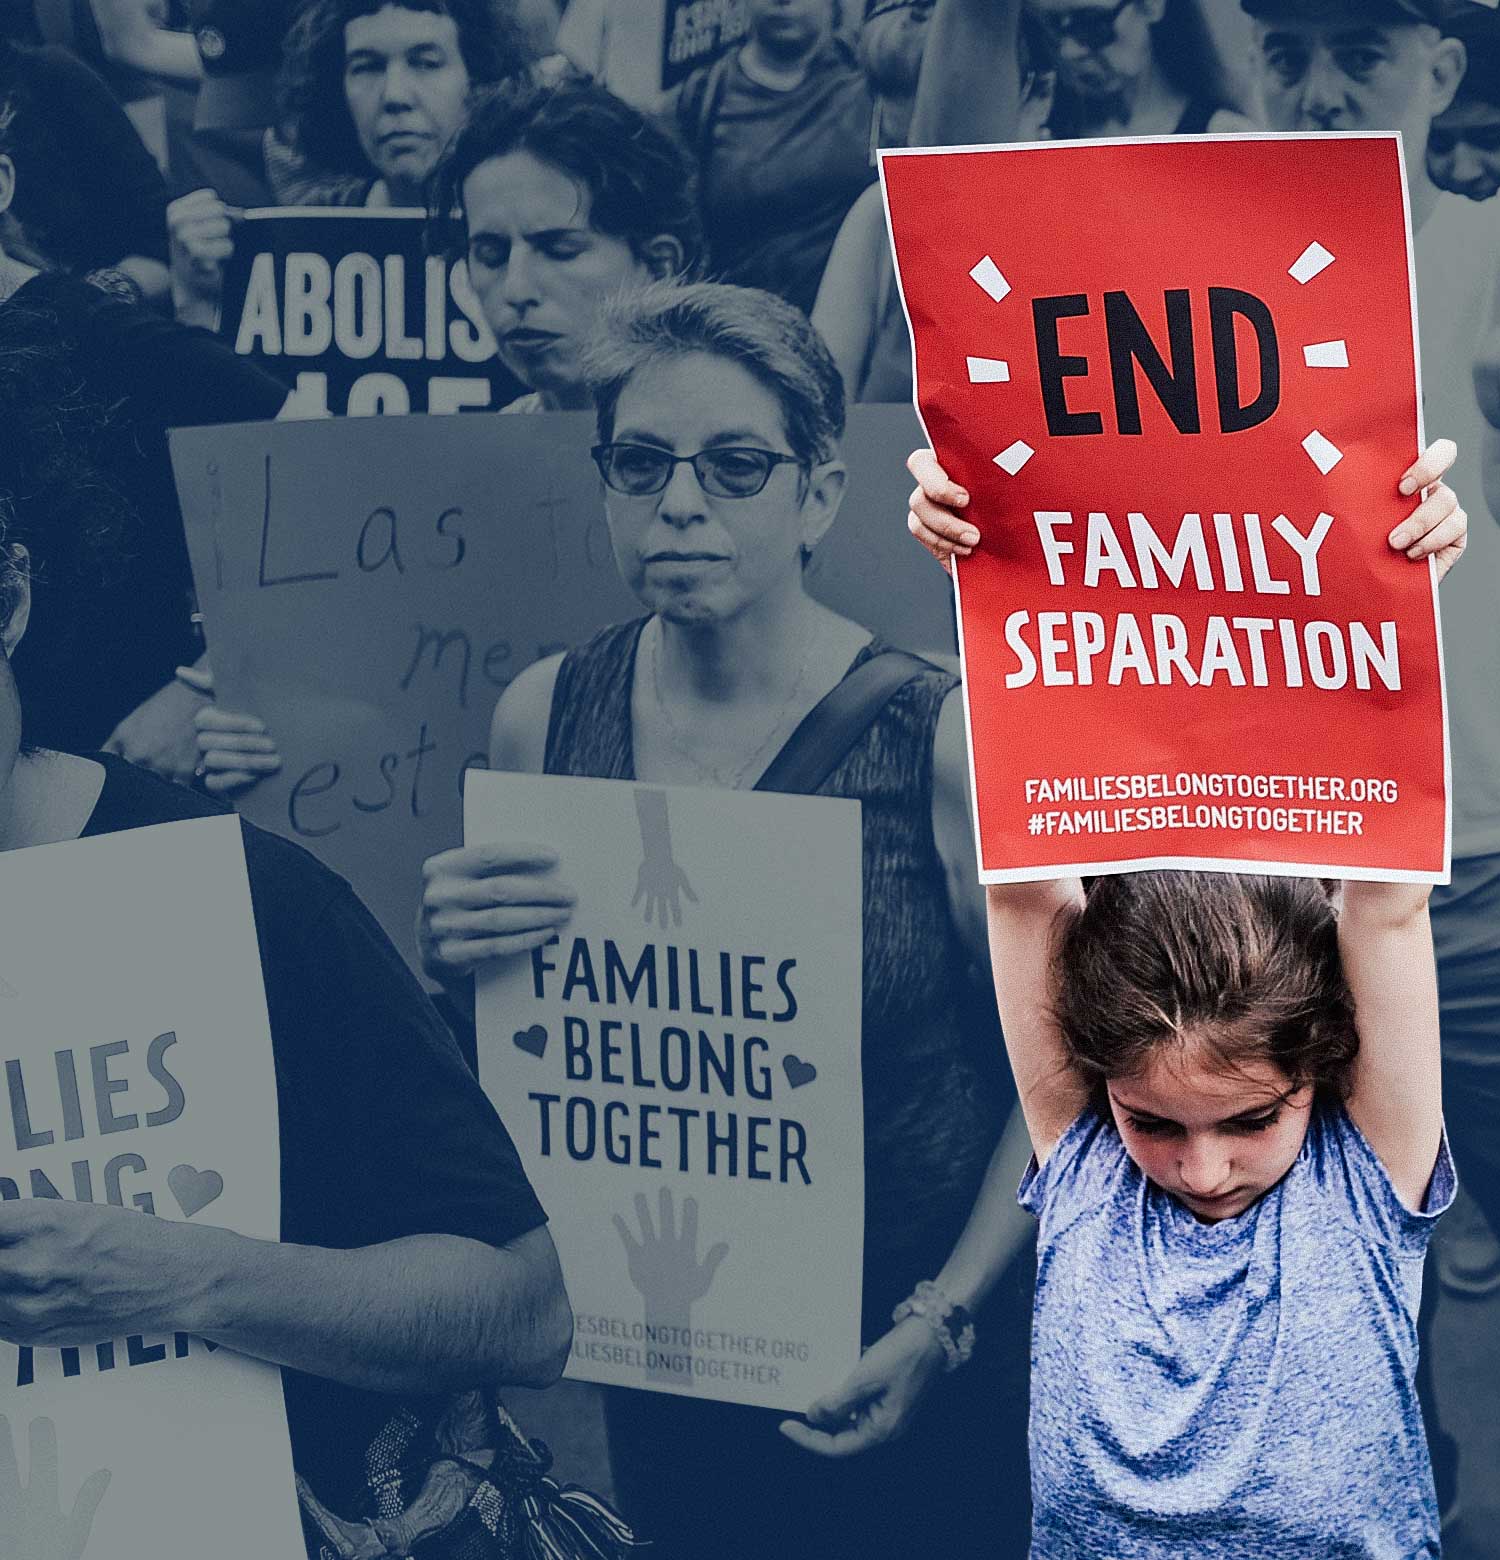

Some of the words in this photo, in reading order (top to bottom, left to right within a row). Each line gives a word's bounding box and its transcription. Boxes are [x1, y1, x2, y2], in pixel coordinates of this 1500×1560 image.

[1031, 287, 1282, 437] END
[1032, 511, 1335, 596] FAMILY
[1004, 610, 1402, 692] SEPARATION
[1025, 774, 1399, 803] FAMILIESBELONGTOGETHER.ORG
[1028, 806, 1364, 836] #FAMILIESBELONGTOGETHER
[530, 934, 798, 1023] FAMILIES
[563, 1015, 773, 1101] BELONG
[528, 1092, 812, 1186] TOGETHER
